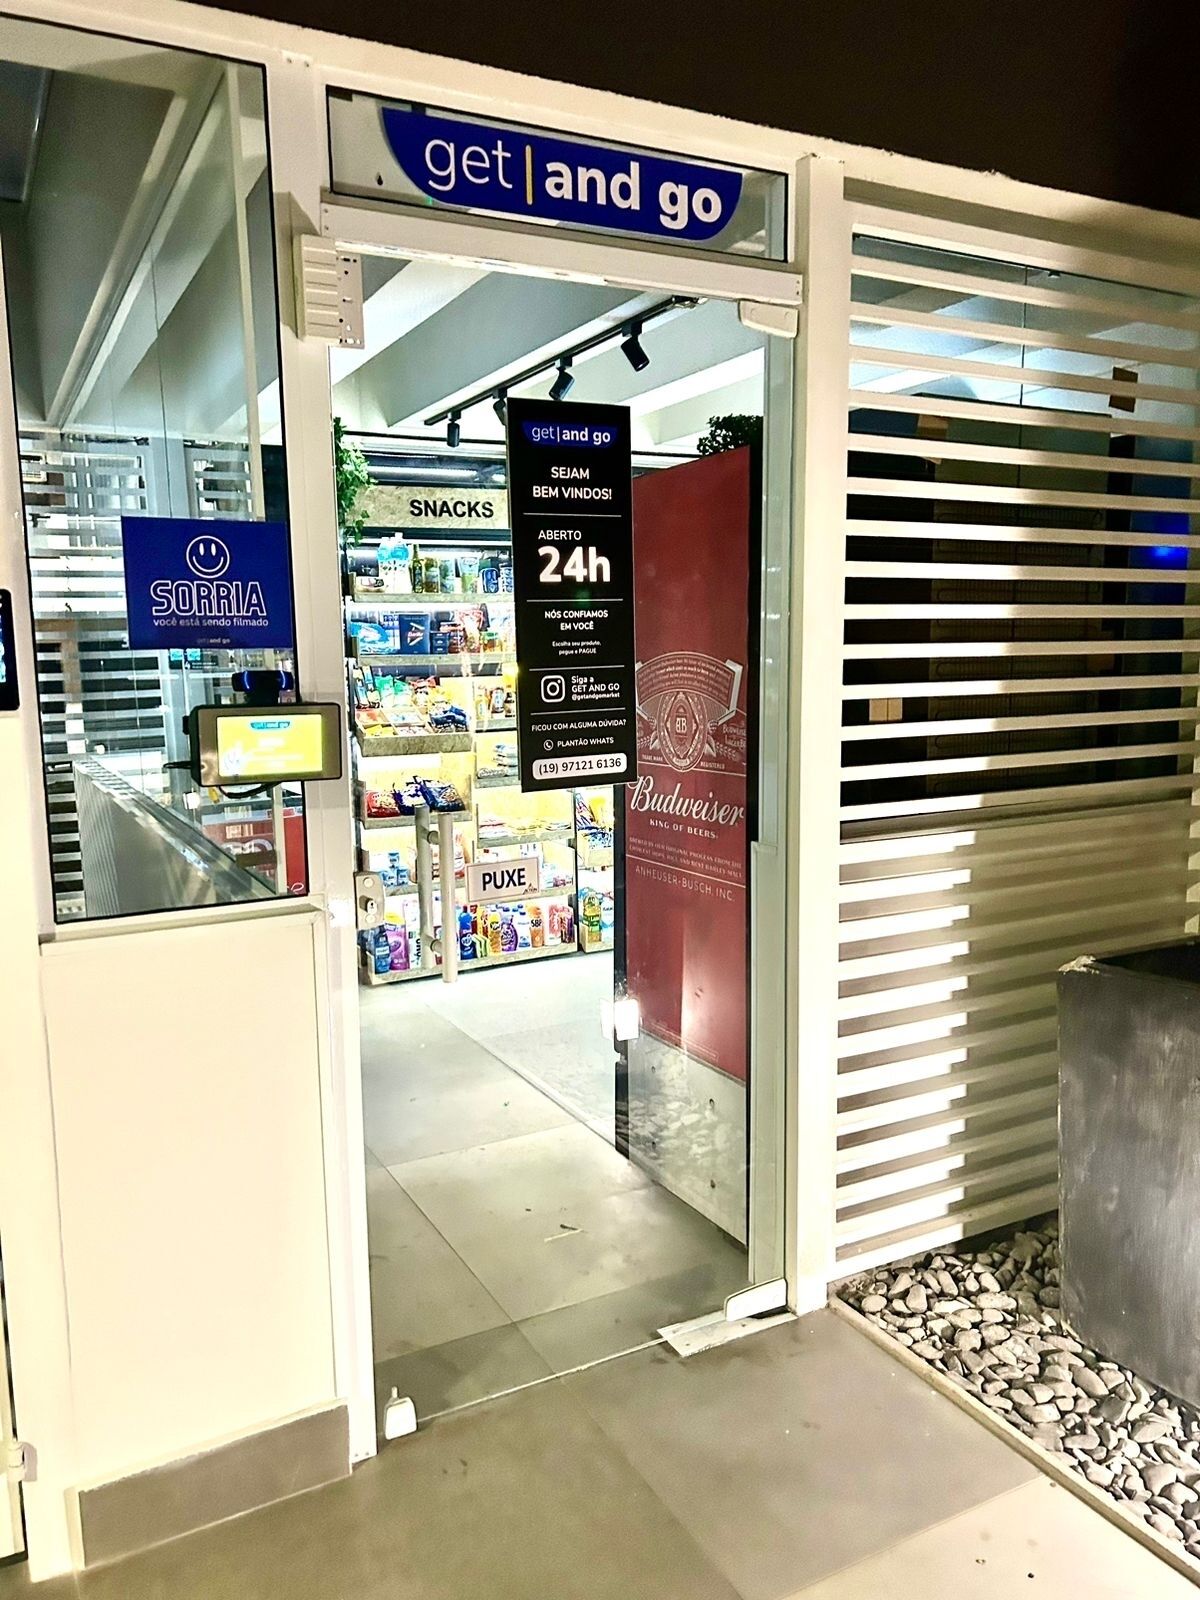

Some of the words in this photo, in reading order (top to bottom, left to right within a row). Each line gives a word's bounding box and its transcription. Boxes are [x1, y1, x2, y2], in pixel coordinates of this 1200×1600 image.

[424, 138, 513, 192] get
[544, 161, 640, 210] and
[658, 181, 722, 230] go
[531, 426, 555, 442] get
[562, 427, 589, 442] and
[593, 432, 611, 446] go
[551, 466, 590, 480] SEJAM
[532, 486, 559, 498] BEM
[562, 487, 612, 500] VINDOS!
[409, 500, 494, 518] SNACKS
[538, 530, 582, 541] ABERTO
[537, 545, 611, 583] 24h
[150, 580, 267, 616] SORRIA
[544, 609, 562, 619] NÓS
[563, 609, 609, 619] CONFIAMOS
[153, 617, 177, 627] você
[179, 616, 201, 627] está
[202, 617, 231, 627] sendo
[233, 616, 269, 627] filmado
[560, 622, 572, 631] EM
[573, 620, 594, 630] VOCÊ
[571, 675, 588, 685] Siga
[571, 685, 587, 693] GET
[588, 684, 607, 692] AND
[608, 682, 620, 691] GO
[571, 691, 620, 701] @getandgomarket
[531, 723, 552, 732] FICOU
[553, 722, 569, 731] COM
[569, 720, 598, 730] ALGUMA
[598, 718, 627, 727] DÚVIDA?
[557, 737, 589, 748] PLANTÃO
[589, 736, 614, 746] WHATS
[538, 762, 559, 775] (19)
[562, 759, 594, 772] 97121
[596, 757, 622, 769] 6136
[627, 775, 744, 826] Budweiser
[649, 818, 670, 830] KING
[672, 823, 683, 832] OF
[482, 868, 527, 891] PUXE
